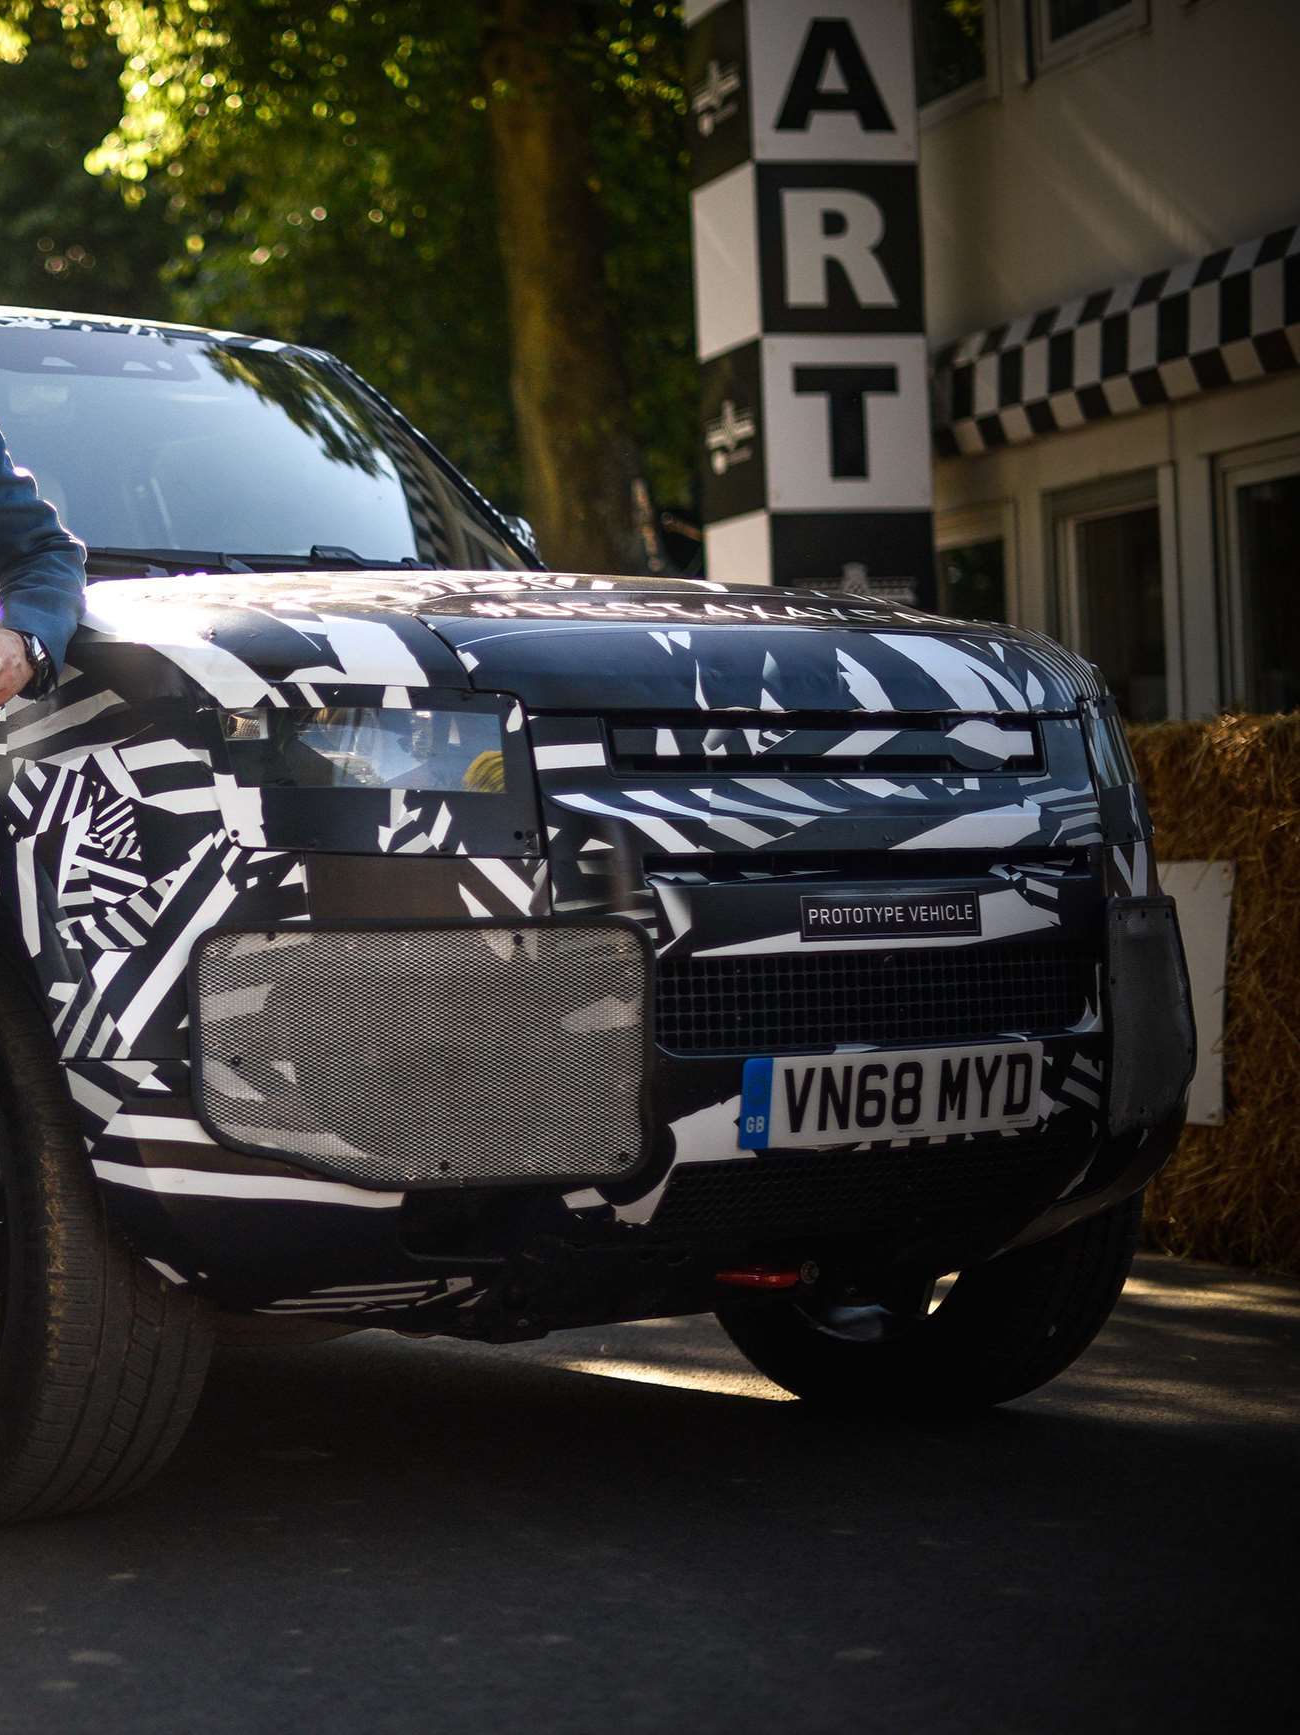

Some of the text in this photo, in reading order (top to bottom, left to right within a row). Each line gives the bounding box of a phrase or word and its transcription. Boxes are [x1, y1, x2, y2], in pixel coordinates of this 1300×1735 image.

[808, 904, 973, 925] PROTOTYPE VEHICLE
[784, 1053, 1033, 1134] VN68 MYD
[745, 1116, 765, 1134] GB
